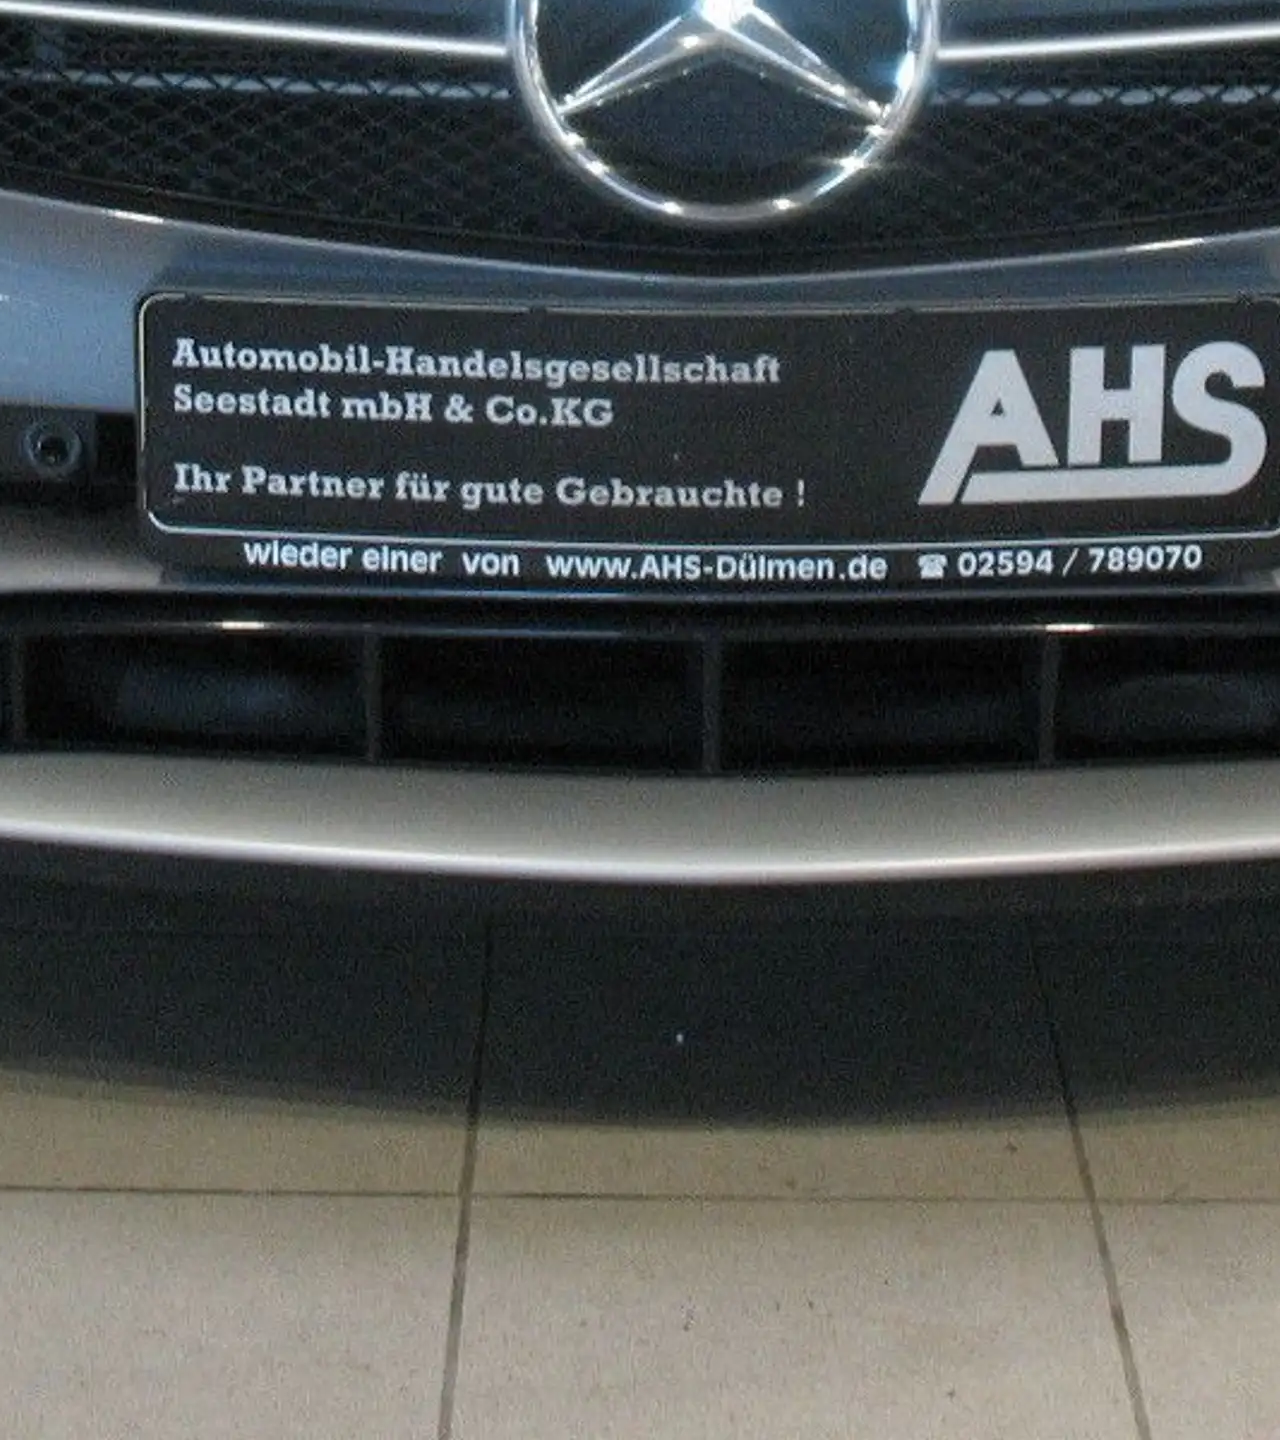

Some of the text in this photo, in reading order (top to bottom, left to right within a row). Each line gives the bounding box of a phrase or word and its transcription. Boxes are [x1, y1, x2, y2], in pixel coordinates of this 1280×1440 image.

[172, 337, 781, 389] Automobil-Handelsgesellschaft
[173, 383, 614, 428] Seestadt mbH & Co.KG
[918, 340, 1268, 505] AHS
[173, 463, 806, 510] Ihr Partner für gute Gebrauchte !
[243, 539, 1203, 581] wieder einer von www.AHS-Dülmen.de 02594 / 789070
